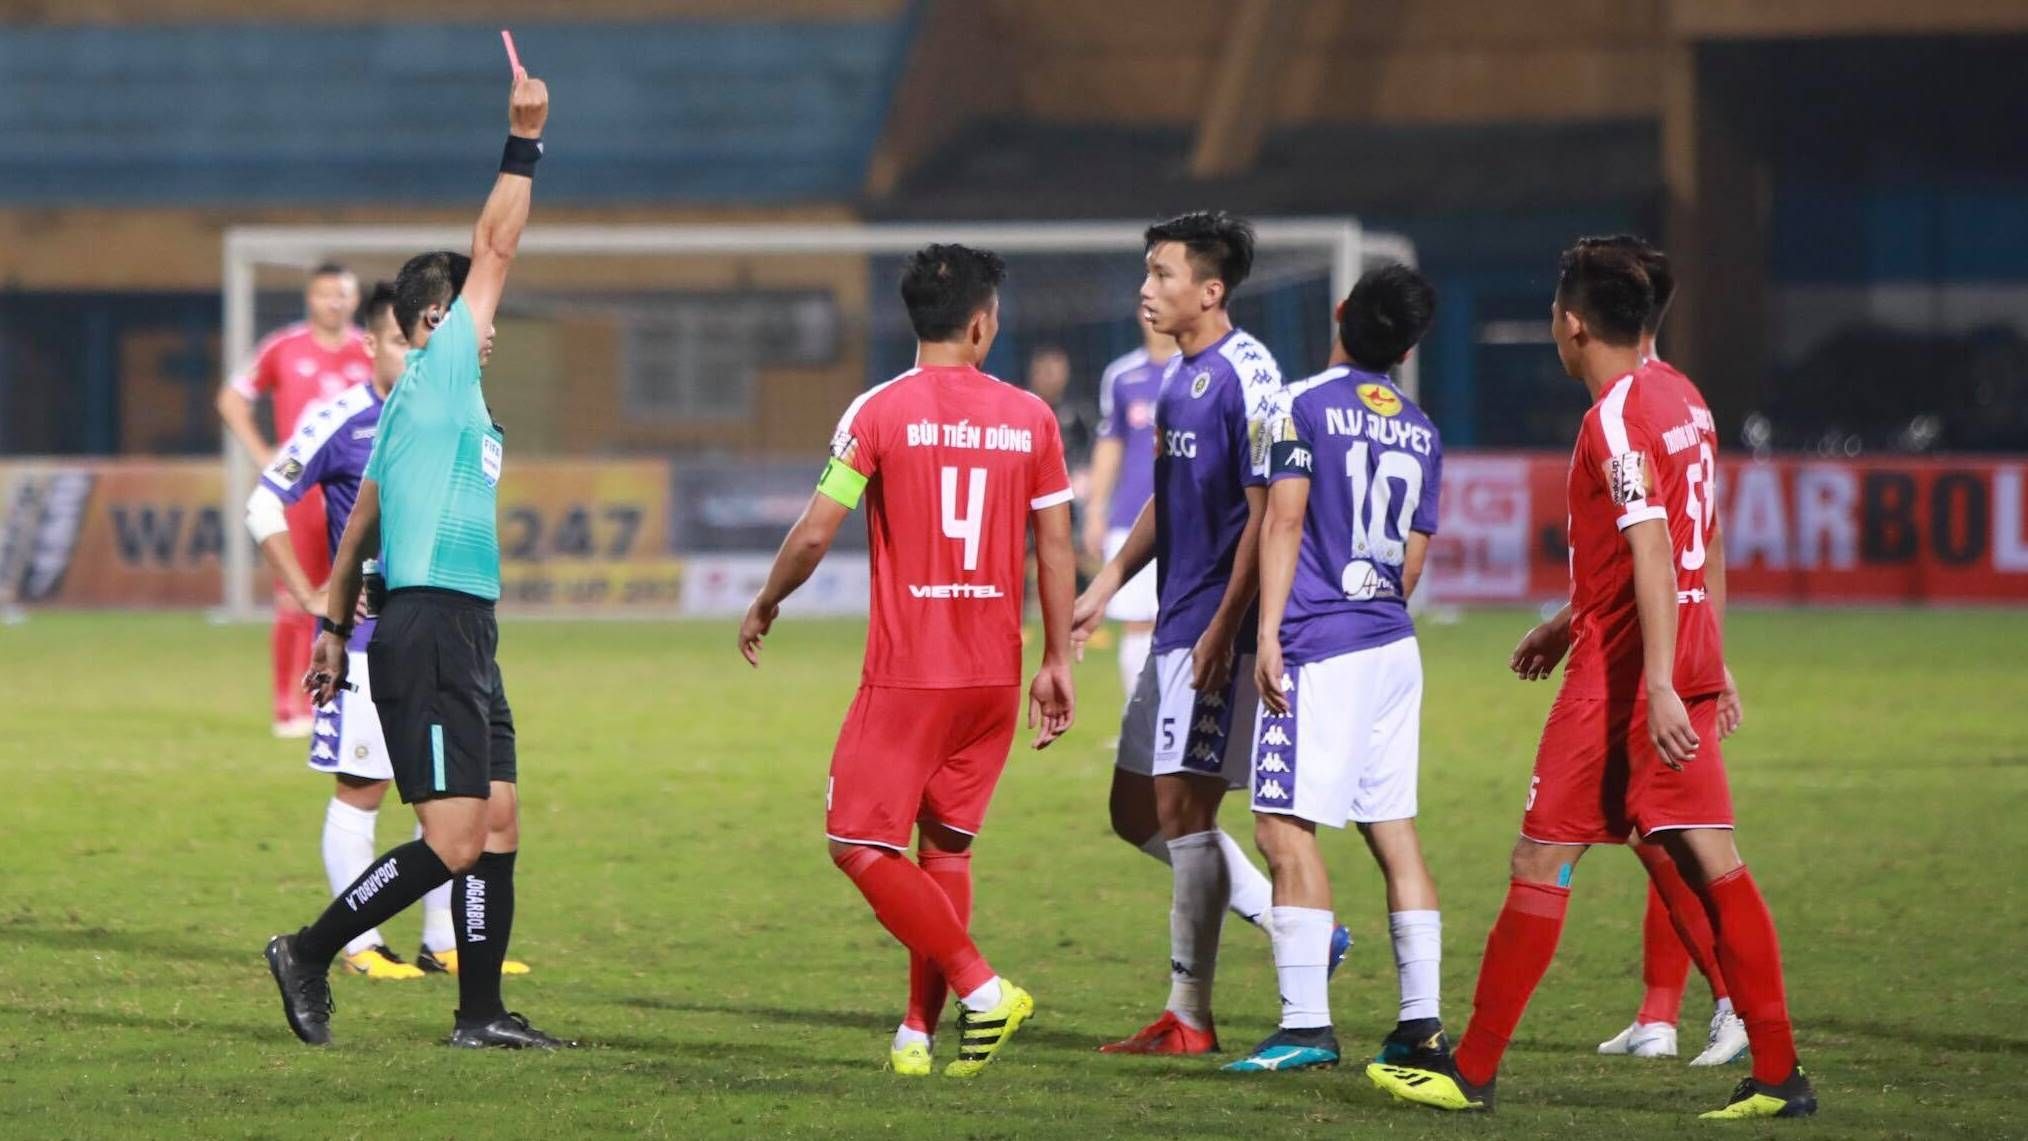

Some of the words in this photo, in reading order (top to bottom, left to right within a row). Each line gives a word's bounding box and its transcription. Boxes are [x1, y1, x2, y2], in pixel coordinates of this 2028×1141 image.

[906, 418, 938, 447] BÙI
[943, 418, 981, 449] TIẾN
[985, 425, 1032, 453] DŨNG
[1166, 429, 1198, 459] SCG
[940, 466, 988, 572] 4
[1346, 441, 1423, 567] 10
[506, 504, 644, 563] 247
[1162, 718, 1175, 750] 5
[345, 858, 399, 911] JOGARBOLA
[466, 875, 487, 942] JOGARBOLA
